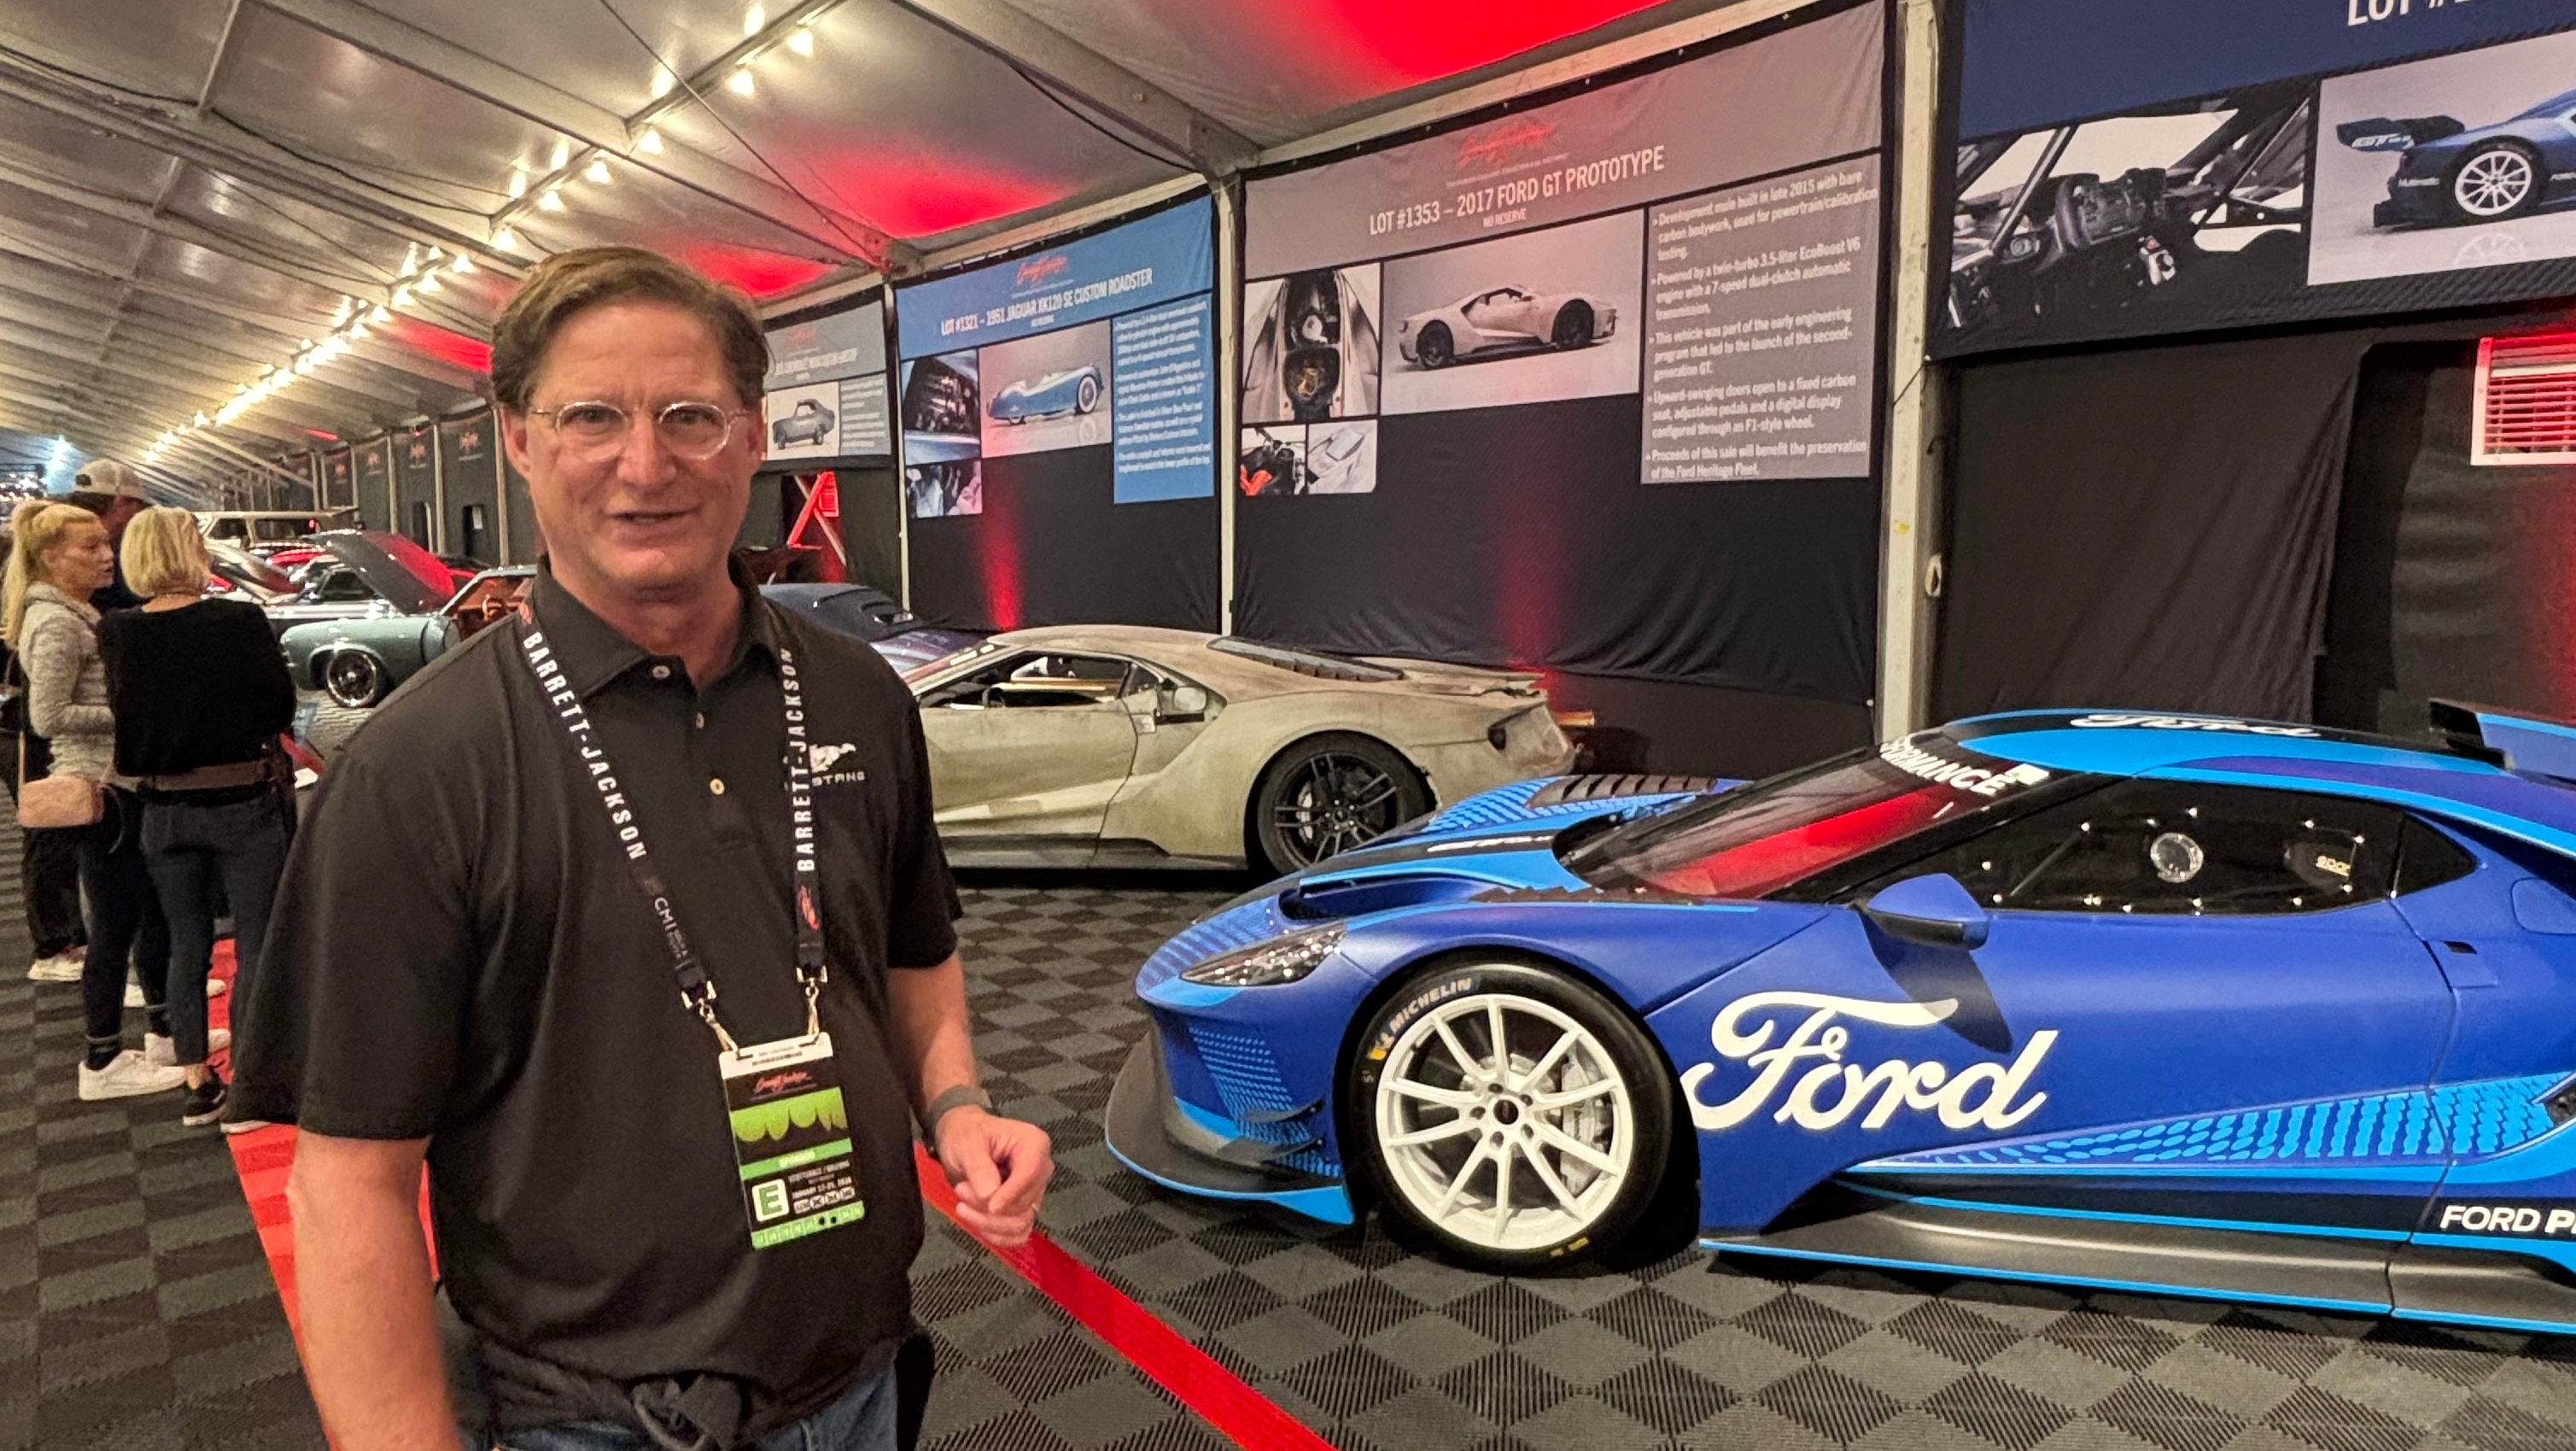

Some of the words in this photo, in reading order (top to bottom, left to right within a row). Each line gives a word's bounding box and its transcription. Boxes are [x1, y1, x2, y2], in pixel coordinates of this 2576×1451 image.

[1370, 210, 1393, 236] LOT
[1397, 201, 1440, 231] #1353
[1457, 188, 1494, 219] 2017
[1498, 178, 1539, 209] FORD
[1542, 172, 1563, 199] GT
[1566, 144, 1665, 193] PROTOTYPE
[1659, 203, 1714, 225] Development
[1738, 193, 1758, 208] built
[1759, 191, 1768, 202] in
[1770, 187, 1788, 201] late
[1790, 178, 1815, 197] 2015
[1817, 176, 1837, 190] with
[1839, 171, 1862, 186] bare
[1483, 216, 1494, 229] NO
[1495, 208, 1527, 226] RESERVE
[1733, 212, 1755, 229] used
[1757, 209, 1770, 222] for
[1656, 268, 1691, 284] Powered
[1693, 266, 1703, 281] by
[1706, 266, 1710, 277] a
[1800, 241, 1845, 260] EcoBoost
[1846, 237, 1860, 252] V6
[1685, 284, 1703, 298] with
[1705, 284, 1710, 295] a
[1712, 277, 1747, 295] 7-speed
[1749, 268, 1801, 289] dual-clutch
[1802, 259, 1850, 279] automatic
[941, 318, 955, 336] LOT
[1007, 300, 1037, 322] JAGUAR
[1063, 291, 1074, 309] SE
[1074, 281, 1107, 306] CUSTOM
[1109, 267, 1153, 295] ROADSTER
[1705, 327, 1720, 337] was
[1722, 321, 1741, 337] part
[1743, 319, 1752, 334] of
[1755, 319, 1769, 331] the
[1771, 315, 1794, 330] early
[1795, 308, 1852, 327] engineering
[1725, 342, 1734, 353] to
[1735, 338, 1750, 352] the
[1751, 335, 1782, 350] launch
[1784, 332, 1794, 347] of
[1796, 331, 1811, 344] the
[1726, 384, 1750, 396] doors
[1752, 382, 1775, 395] open
[1777, 379, 1786, 392] to
[1788, 380, 1794, 391] a
[1796, 375, 1820, 389] fixed
[1821, 374, 1855, 388] carbon
[1749, 400, 1767, 412] and
[1775, 397, 1805, 413] digital
[1807, 394, 1842, 410] display
[1733, 421, 1744, 432] an
[1745, 416, 1782, 433] F1-style
[1691, 447, 1700, 460] of
[1701, 446, 1718, 459] this
[1719, 445, 1737, 458] sale
[1738, 444, 1754, 457] will
[1755, 442, 1788, 456] benefit
[1790, 442, 1805, 455] the
[1807, 440, 1866, 457] preservation
[1651, 466, 1659, 479] of
[1661, 466, 1675, 479] the
[1677, 465, 1695, 478] Ford
[523, 631, 647, 861] BARRETT-JACKSON
[780, 647, 815, 872] BARRETT-JACKSON
[1389, 978, 1472, 1033] MICHELIN
[1679, 990, 2059, 1130] Ford
[758, 1185, 782, 1216] E
[2439, 1205, 2541, 1232] FORD
[2544, 1209, 2576, 1235] P
